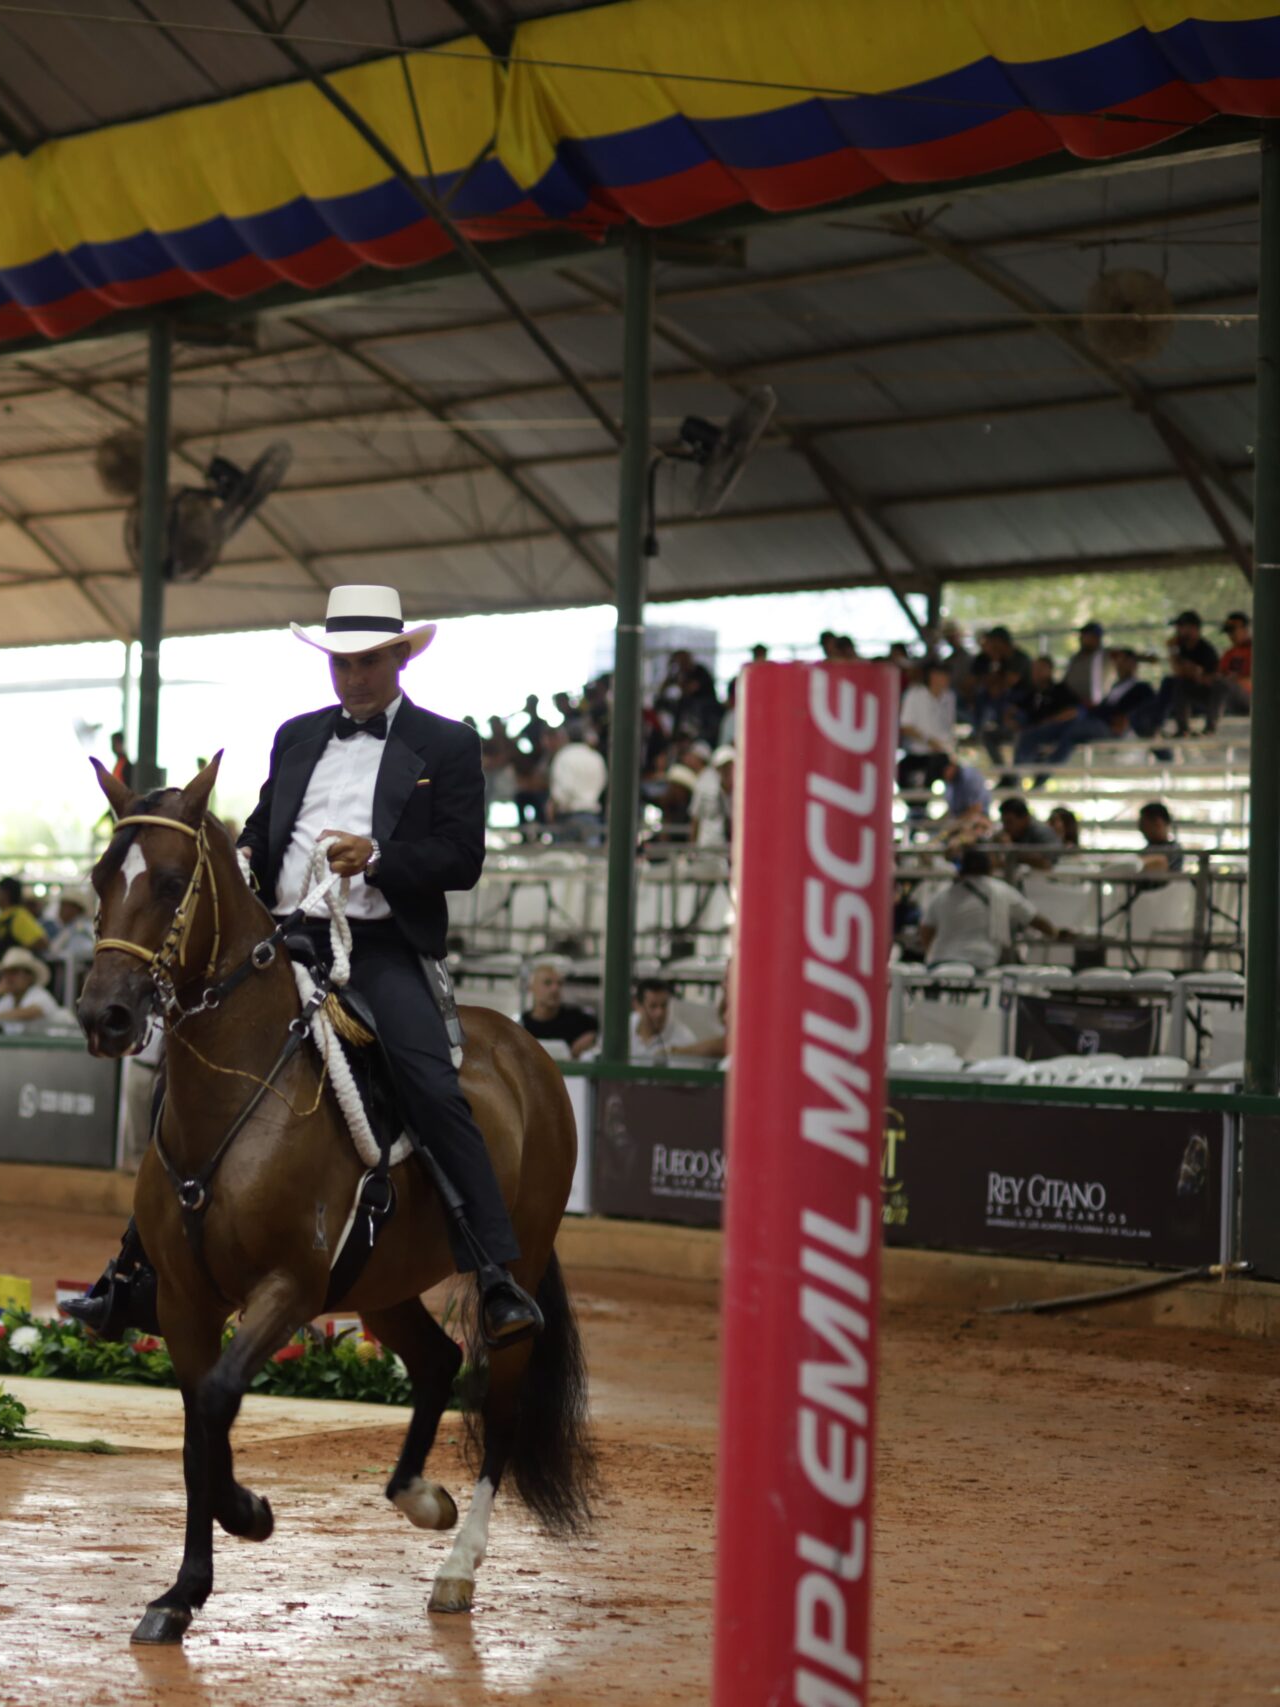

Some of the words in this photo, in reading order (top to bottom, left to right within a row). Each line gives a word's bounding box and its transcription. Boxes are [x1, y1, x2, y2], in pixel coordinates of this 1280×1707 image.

[800, 667, 880, 1168] MUSCLE
[987, 1171, 1024, 1206] REY
[1027, 1173, 1106, 1212] GITANO
[986, 1204, 1003, 1216] DE
[1014, 1206, 1044, 1219] LOS
[1054, 1208, 1127, 1225] ACANTOS
